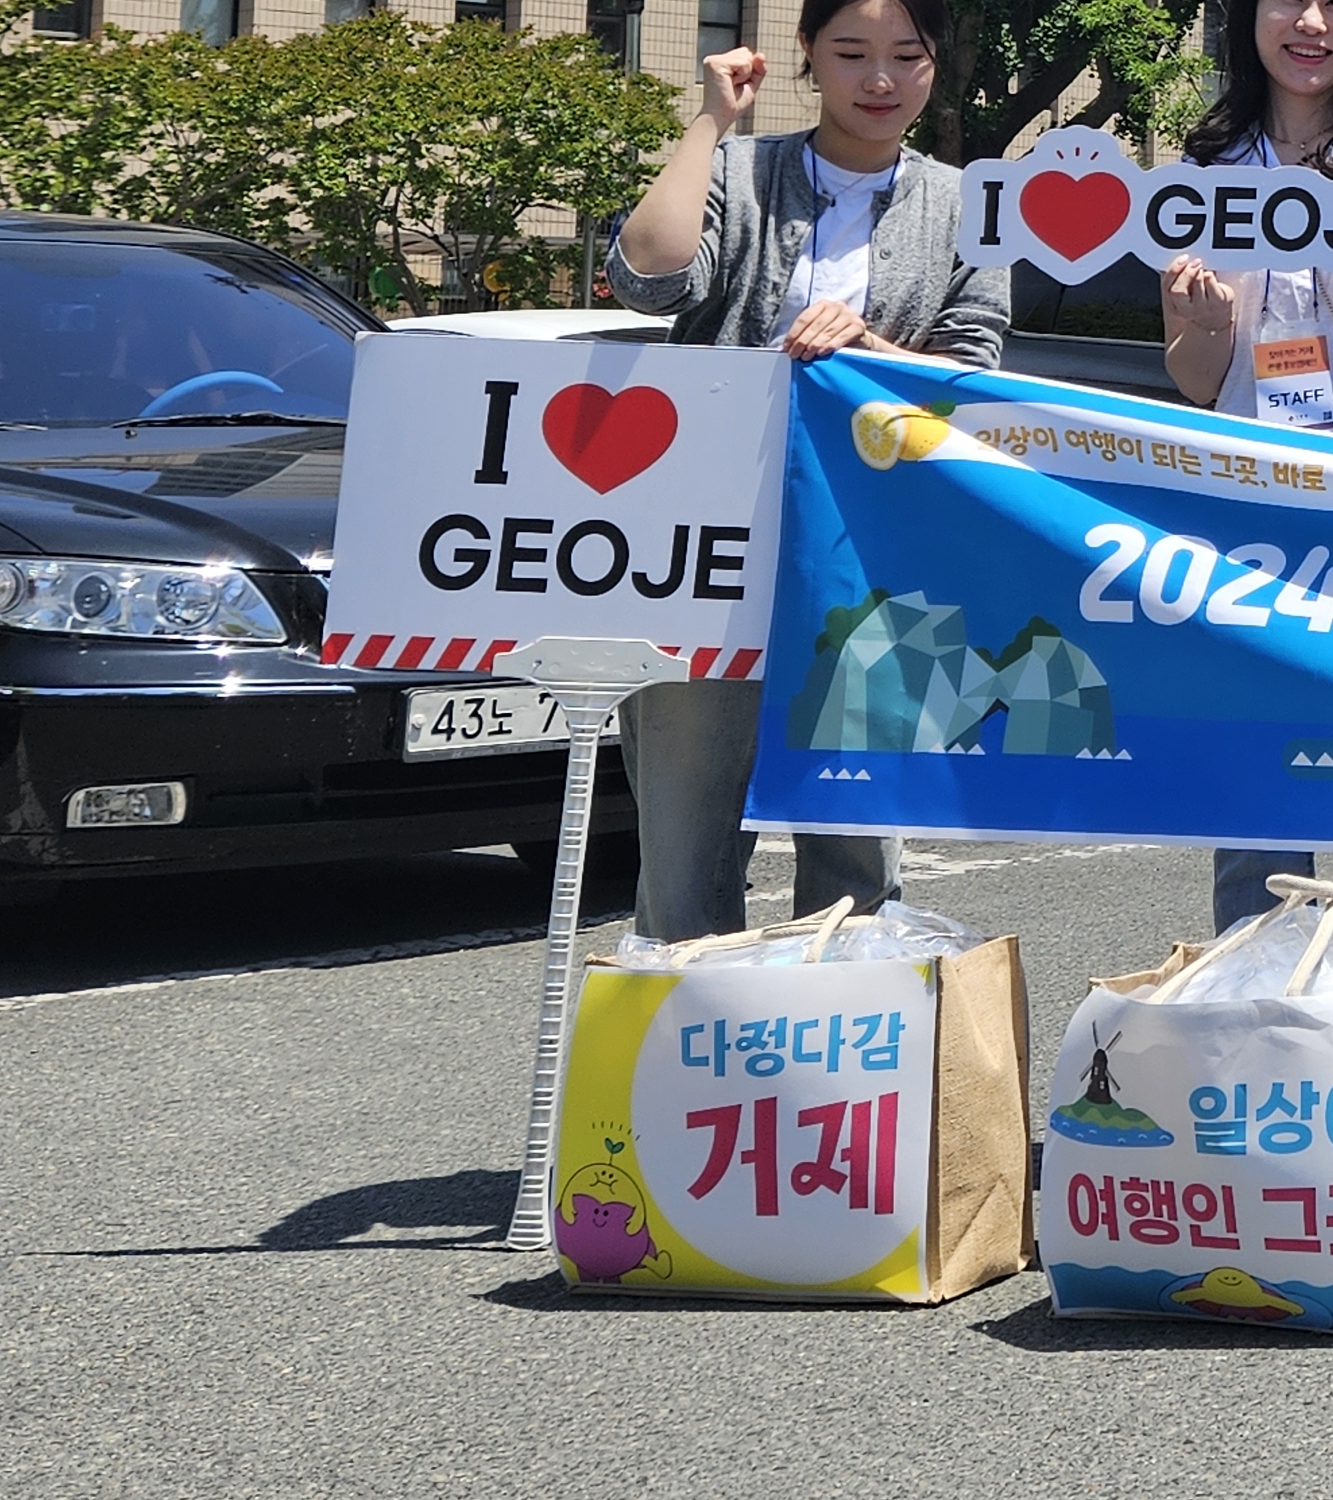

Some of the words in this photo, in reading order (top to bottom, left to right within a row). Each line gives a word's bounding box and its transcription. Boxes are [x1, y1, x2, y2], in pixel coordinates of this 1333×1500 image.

[979, 181, 1003, 246] I
[473, 380, 519, 485] I
[1268, 388, 1324, 409] STAFF
[973, 424, 1058, 458] 일상이
[1064, 428, 1144, 463] 여행이
[1151, 441, 1202, 476] 되는
[1208, 453, 1268, 489] 그곳,
[1272, 462, 1326, 492] 바로
[418, 513, 751, 601] GEOJE
[430, 697, 513, 742] 43노
[679, 1011, 906, 1078] 다정다감
[686, 1091, 900, 1217] 거제
[1066, 1172, 1241, 1251] 여행인
